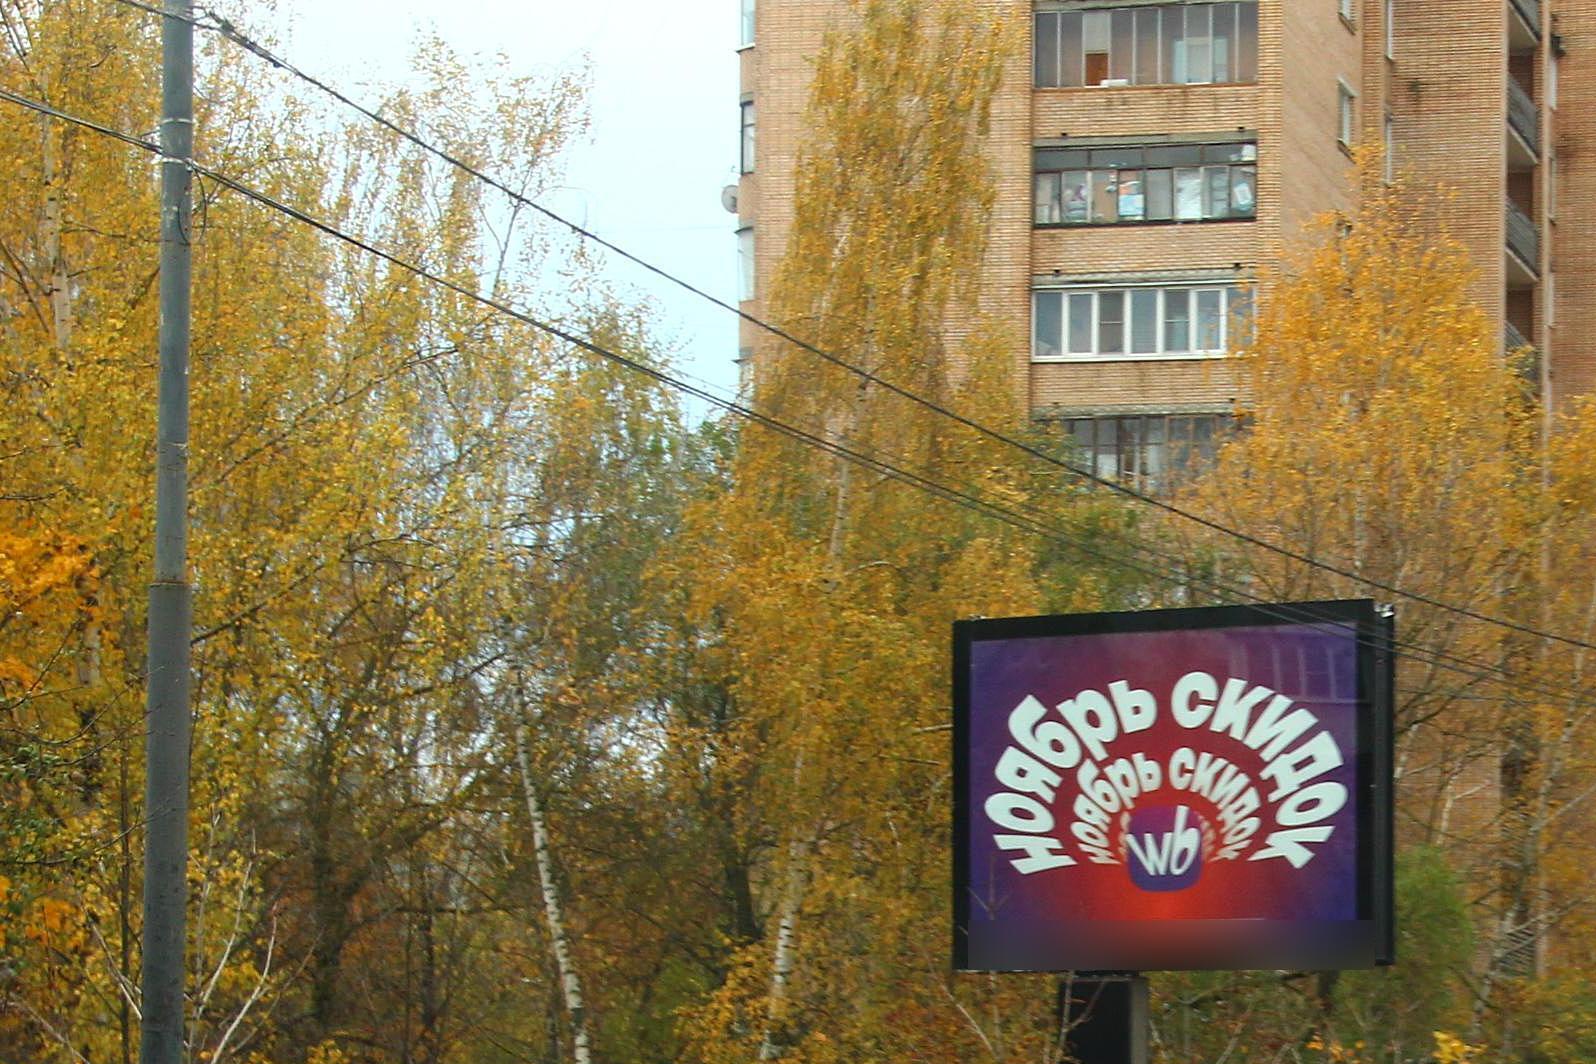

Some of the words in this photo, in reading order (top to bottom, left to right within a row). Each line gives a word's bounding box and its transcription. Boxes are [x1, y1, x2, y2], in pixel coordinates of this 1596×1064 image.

[985, 681, 1157, 875] ноябрь
[1172, 672, 1347, 868] скидок
[1071, 752, 1162, 864] ноябрь
[1169, 747, 1261, 862] скидок
[1127, 806, 1202, 875] wb
